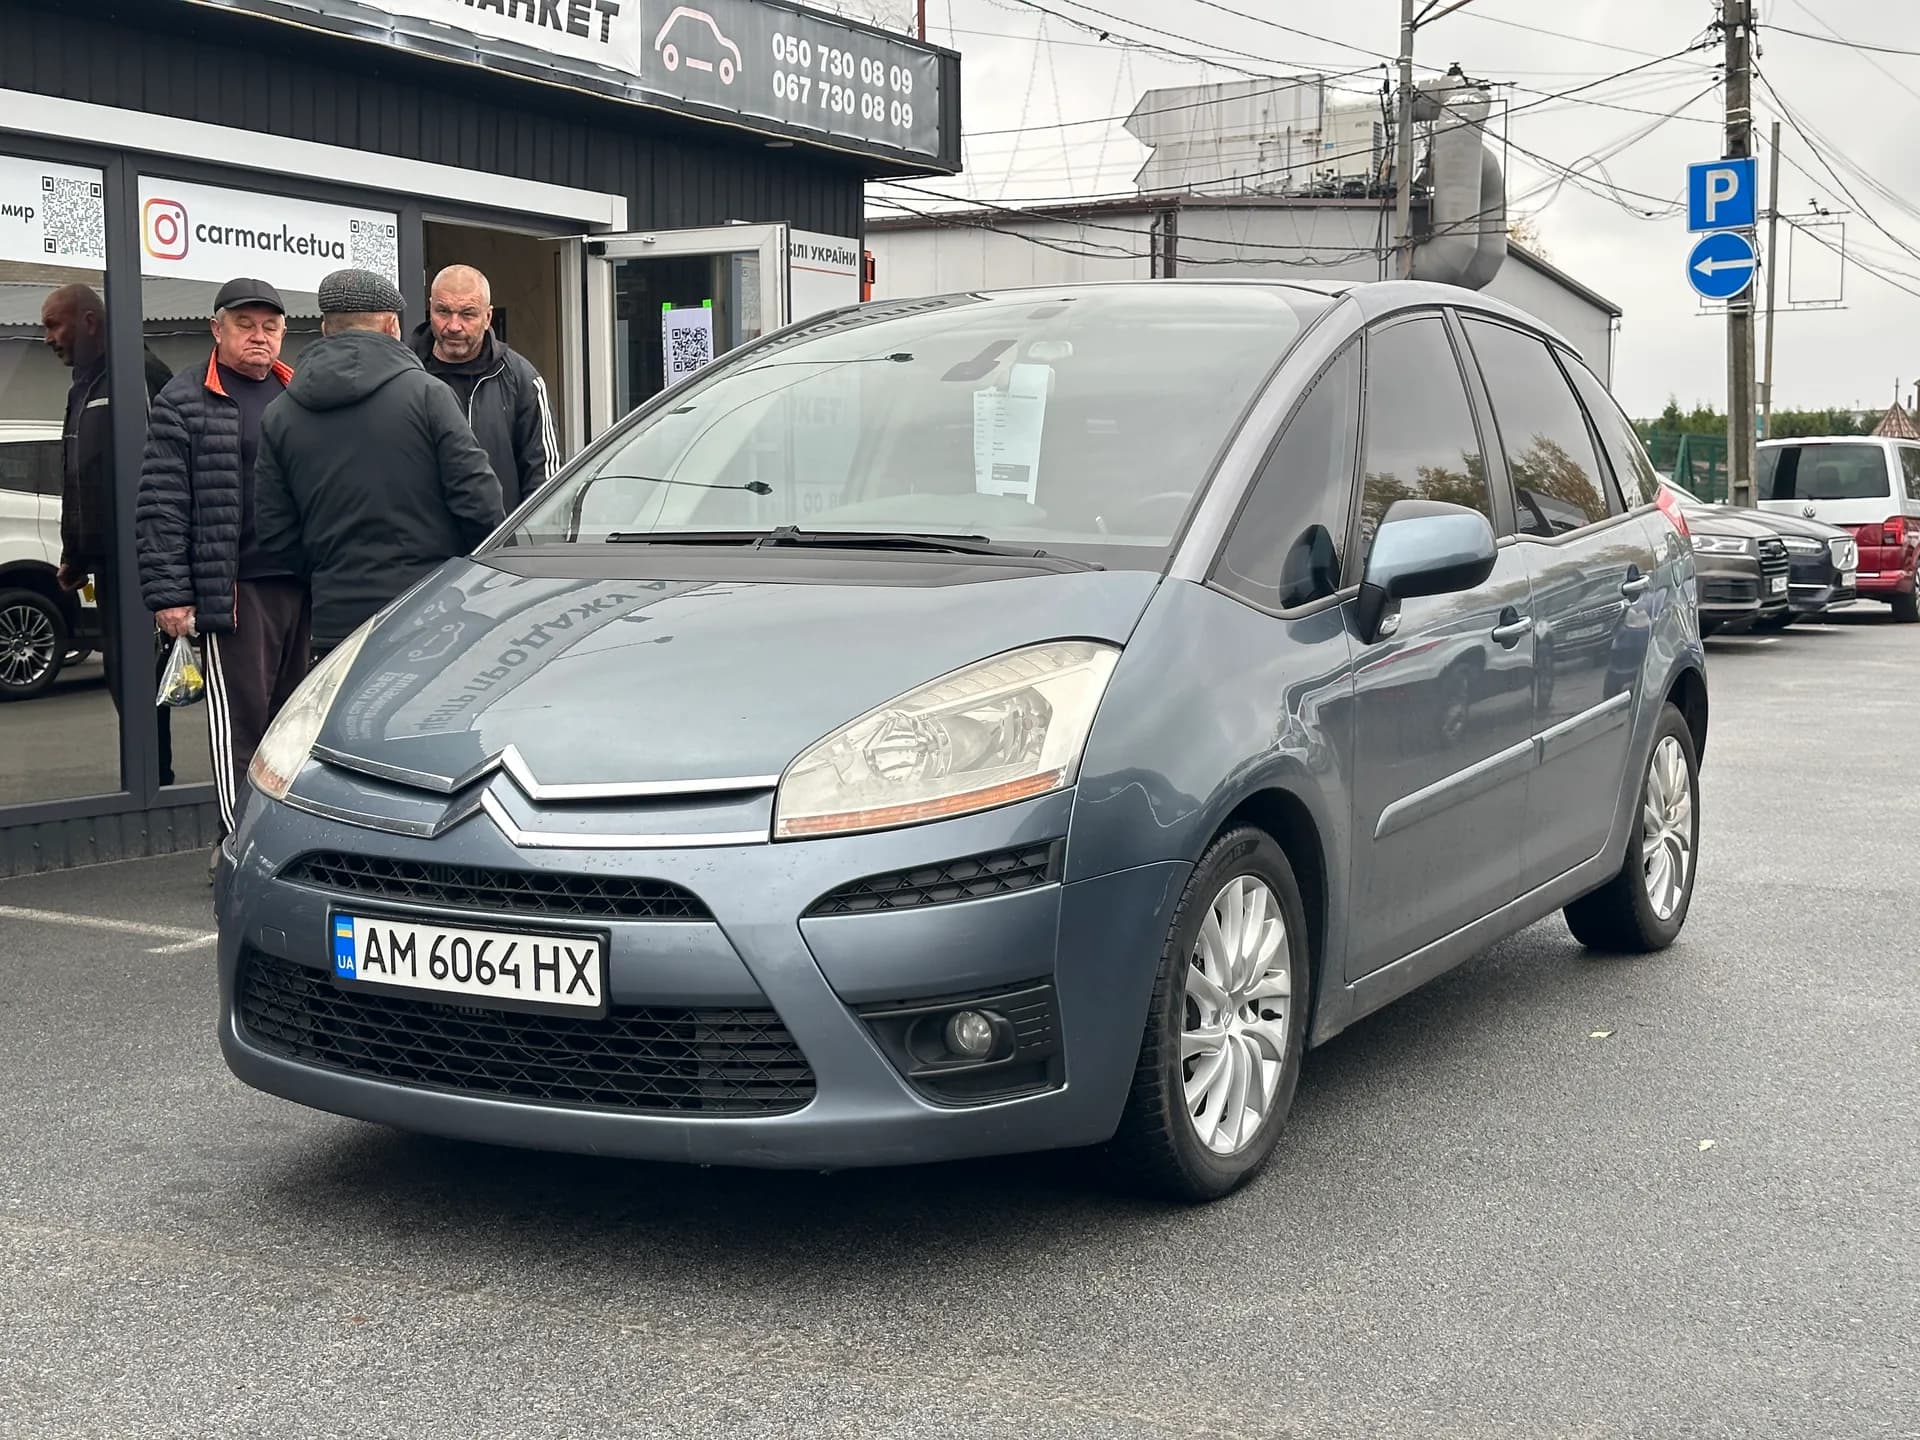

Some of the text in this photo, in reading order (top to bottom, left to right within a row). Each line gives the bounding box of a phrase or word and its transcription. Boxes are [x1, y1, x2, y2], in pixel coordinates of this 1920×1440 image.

[772, 32, 913, 95] 050 730 08 09
[772, 70, 913, 129] 067 730 08 09
[1705, 168, 1739, 222] P
[195, 223, 345, 260] carmarketua
[810, 245, 857, 267] УКРАЇНИ
[338, 955, 354, 970] UA
[362, 927, 595, 996] AM 6064 HX
